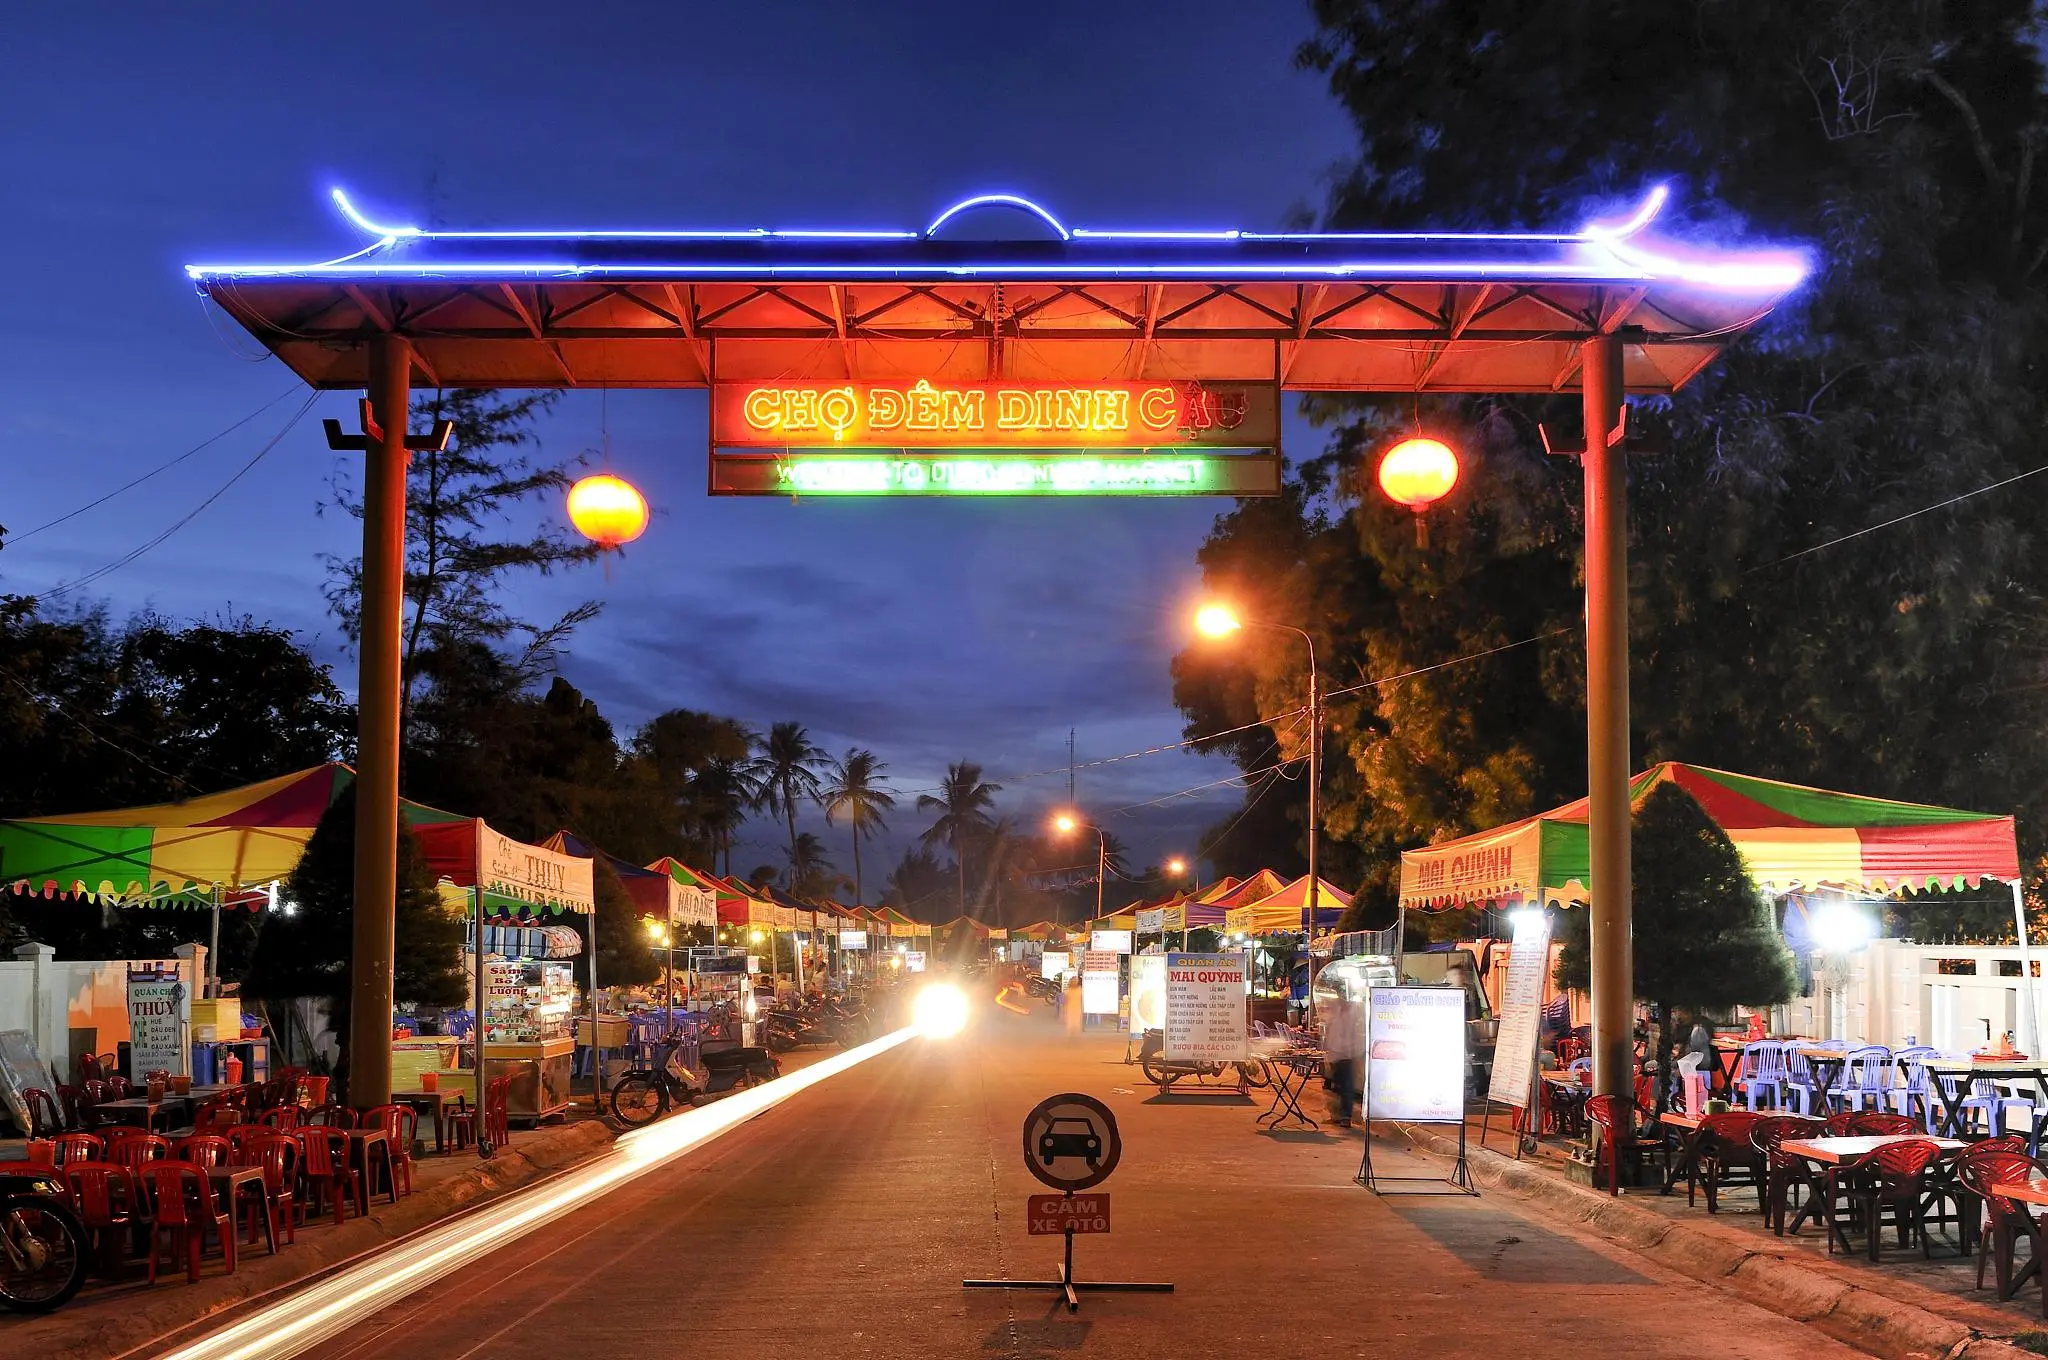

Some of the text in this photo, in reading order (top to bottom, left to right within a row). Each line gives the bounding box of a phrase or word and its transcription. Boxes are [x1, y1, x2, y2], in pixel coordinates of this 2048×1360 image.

[744, 386, 858, 441] CHỢ
[868, 379, 985, 429] ĐÊM
[997, 389, 1129, 429] DINH
[1418, 859, 1445, 889] MAI
[1170, 969, 1242, 983] MAI QUỲNH
[134, 987, 160, 998] QUÁN
[489, 986, 528, 997] Lượng
[1032, 1215, 1107, 1232] XE ÔTÔ
